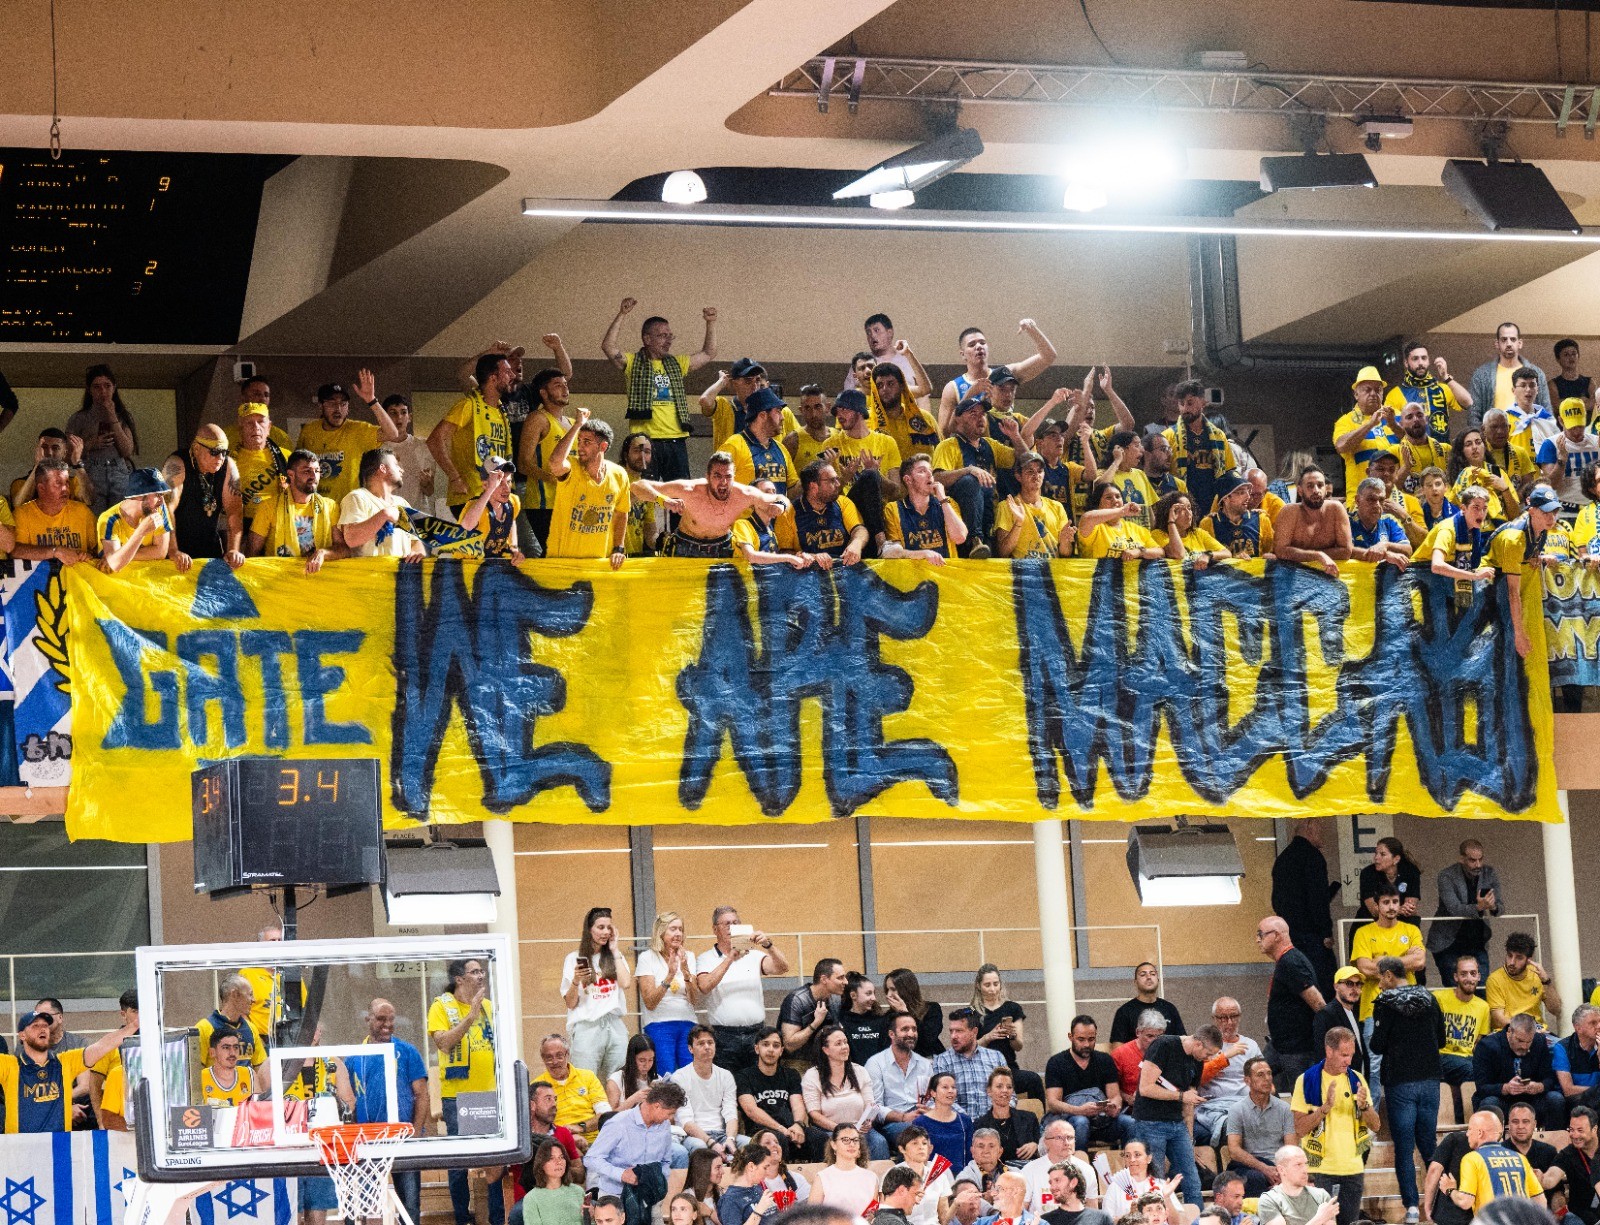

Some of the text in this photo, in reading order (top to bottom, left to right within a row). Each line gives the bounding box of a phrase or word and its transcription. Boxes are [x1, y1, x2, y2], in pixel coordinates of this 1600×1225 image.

[159, 177, 170, 191] 9
[145, 261, 157, 275] 2
[1565, 407, 1582, 417] MTA
[490, 422, 503, 439] THE
[570, 521, 576, 531] IS
[37, 532, 82, 549] MACCABI
[806, 529, 845, 547] MTA
[908, 529, 943, 546] MTA
[95, 617, 373, 751] GATE
[391, 555, 612, 821] WE
[676, 557, 959, 818] ARE
[201, 775, 220, 814] 3.4
[278, 768, 339, 806] 3.4
[398, 927, 419, 935] RANGS
[393, 963, 405, 973] 22
[23, 1081, 60, 1098] MTA
[754, 1089, 789, 1104] LACOSTE
[178, 1134, 208, 1142] AIRLINES
[165, 1156, 202, 1167] SPALDING
[1487, 1156, 1522, 1169] GATE
[1498, 1171, 1525, 1199] 11
